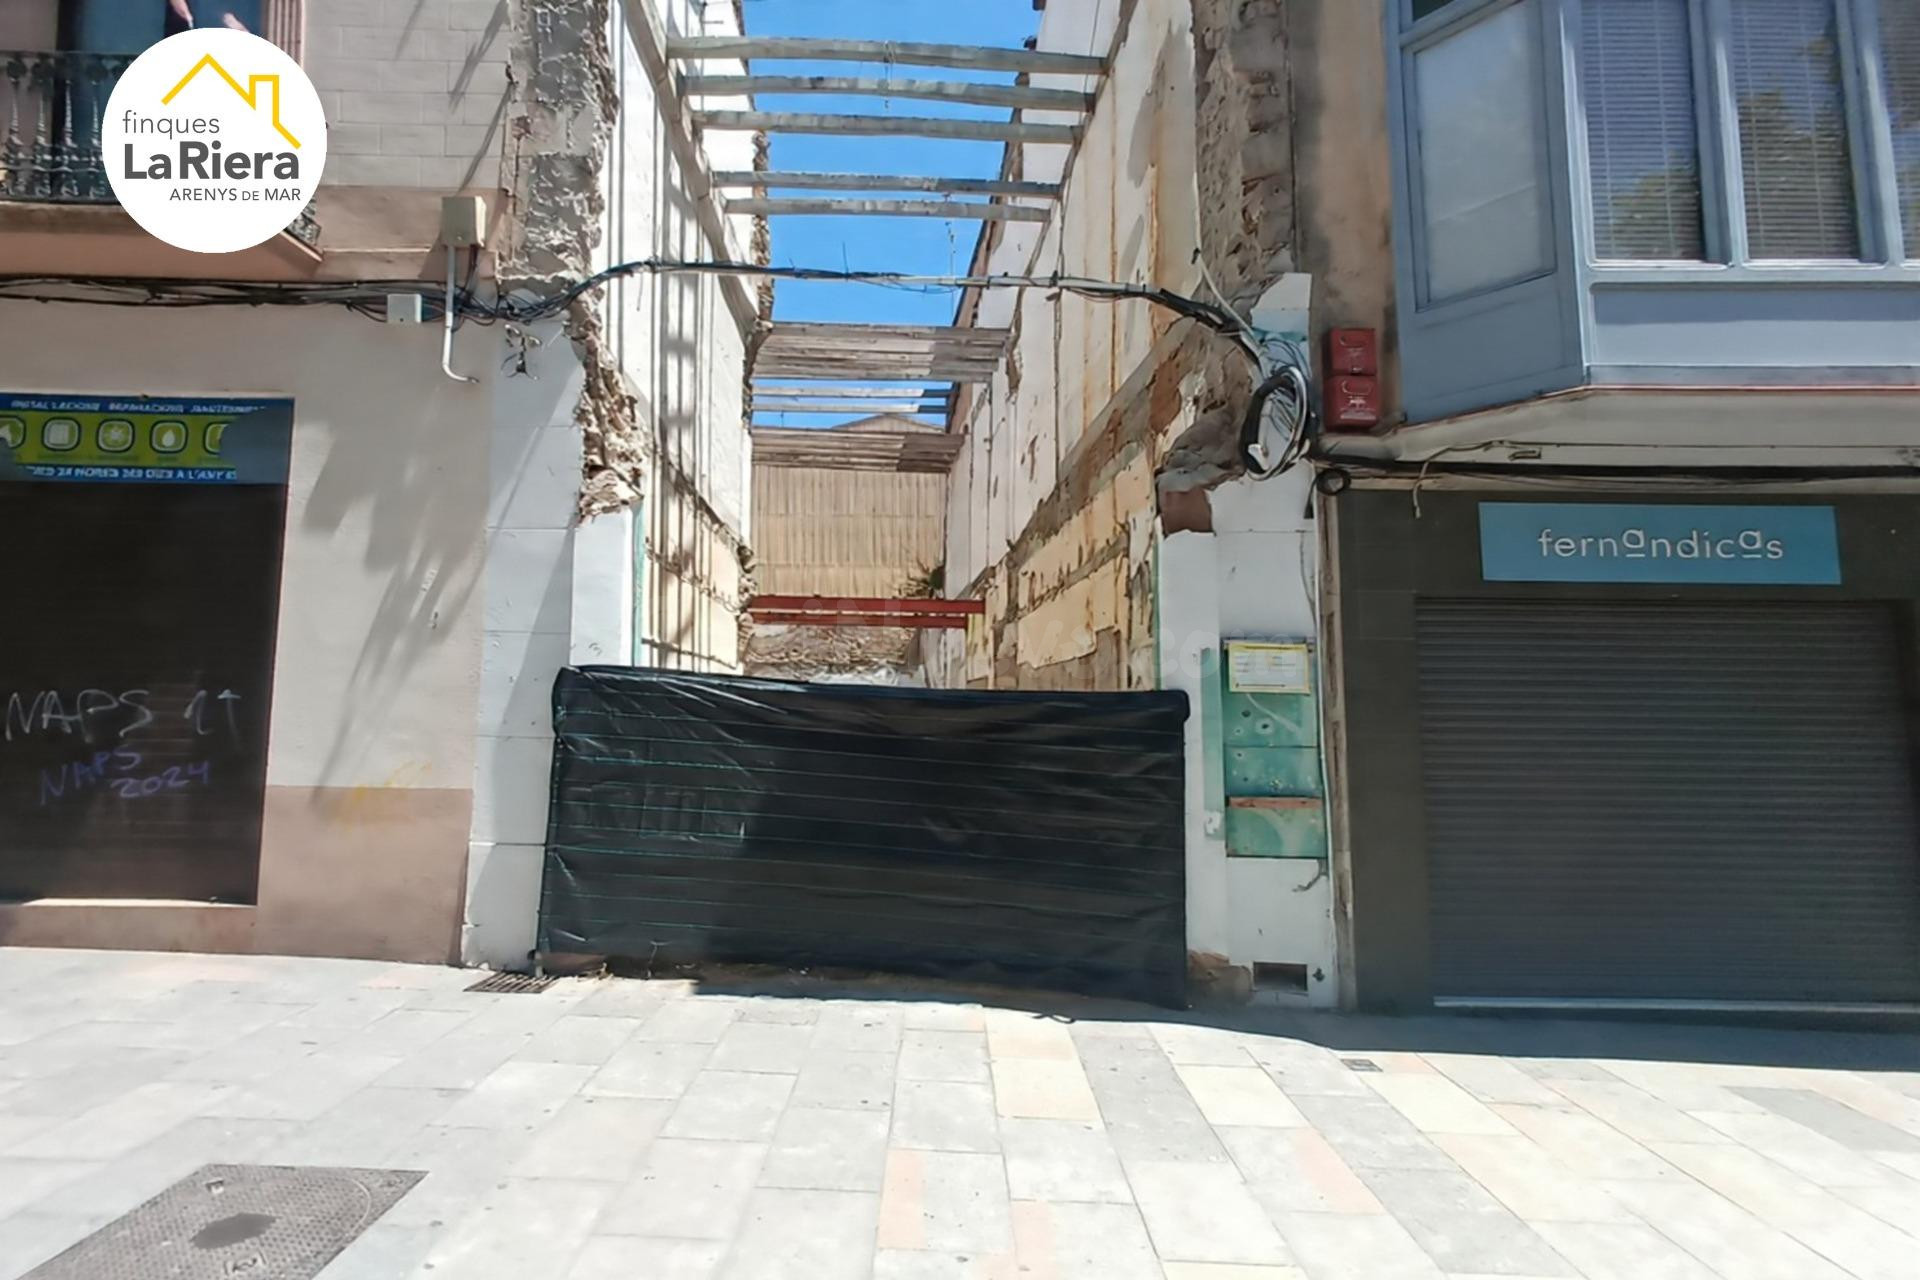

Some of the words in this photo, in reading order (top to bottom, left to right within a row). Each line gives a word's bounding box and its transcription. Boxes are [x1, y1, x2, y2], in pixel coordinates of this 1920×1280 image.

[5, 689, 152, 743] NAPS
[40, 744, 142, 806] NAPS
[110, 761, 210, 798] 2024
